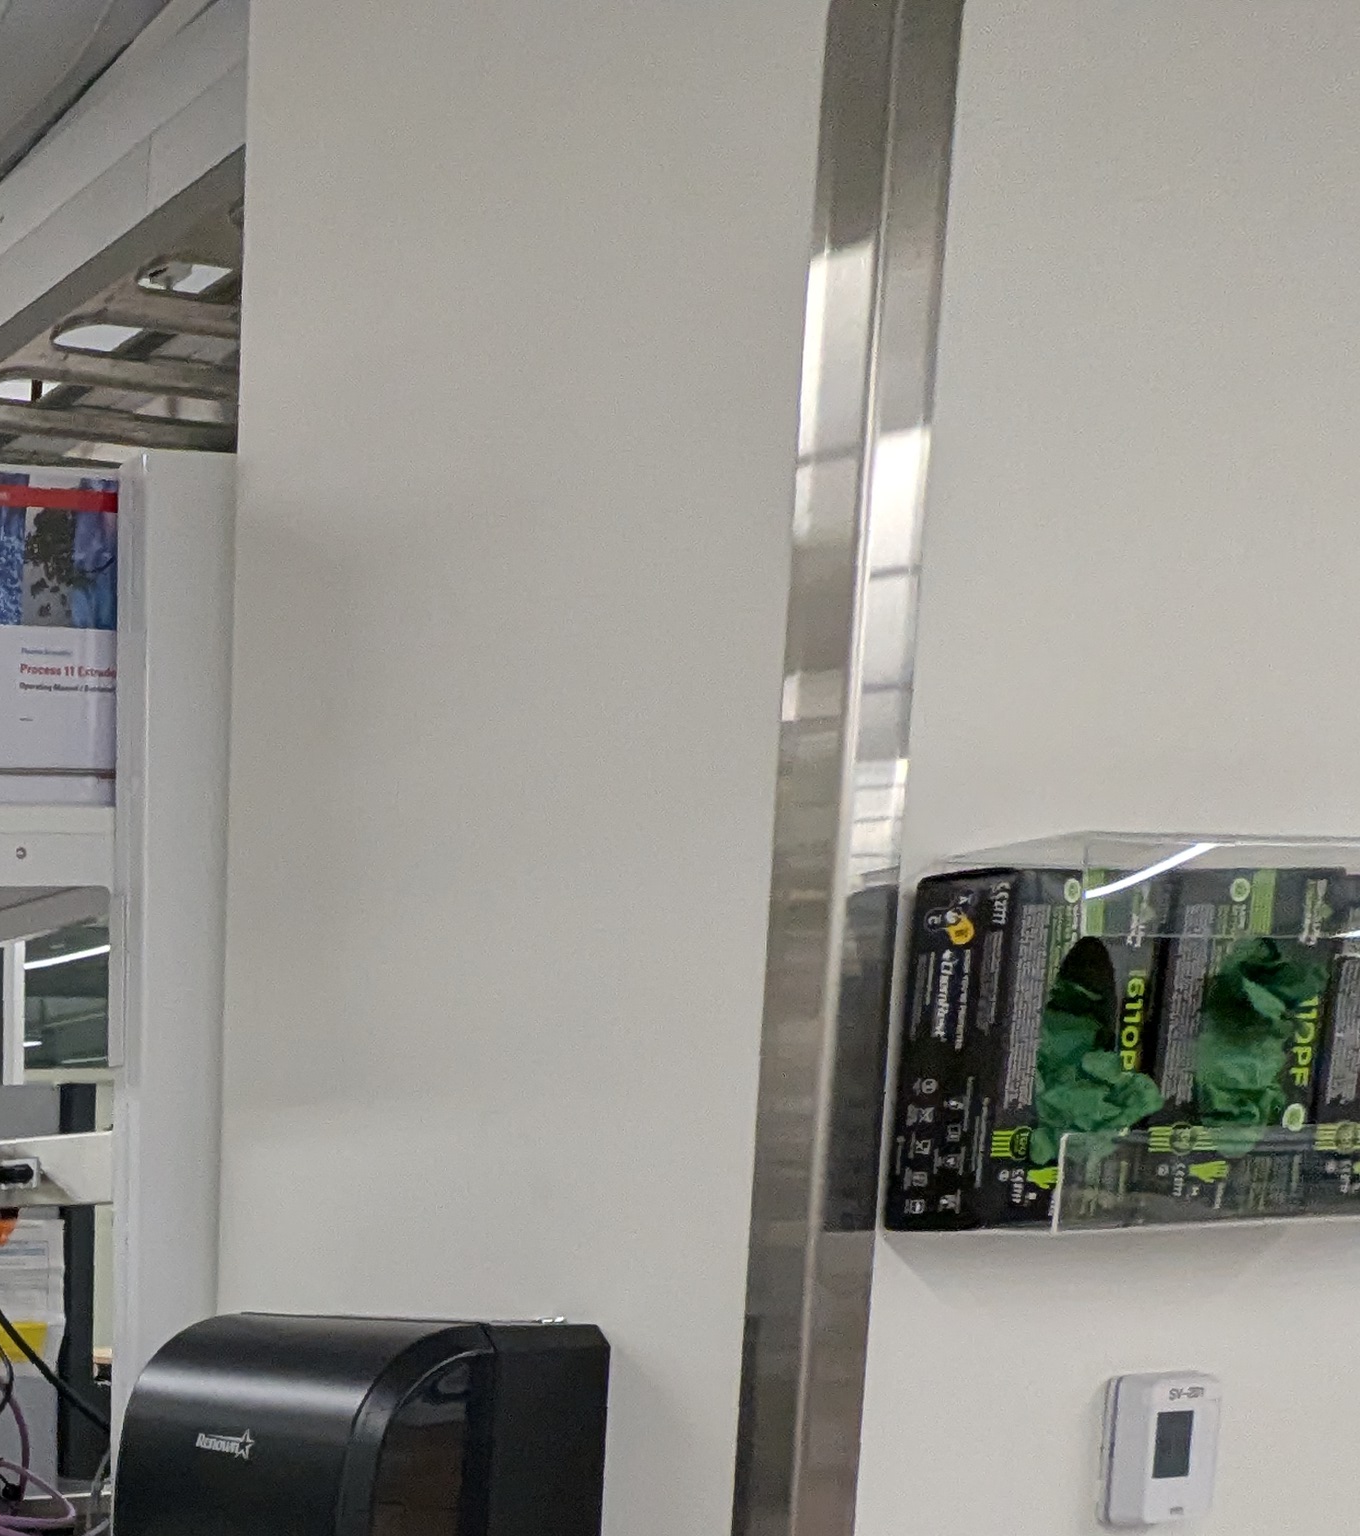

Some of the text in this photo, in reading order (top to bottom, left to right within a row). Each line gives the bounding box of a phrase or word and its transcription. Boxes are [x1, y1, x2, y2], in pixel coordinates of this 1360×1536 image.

[19, 663, 117, 679] Process 11 Extrude
[1120, 977, 1145, 1072] 6110P
[1289, 995, 1319, 1088] 110PF
